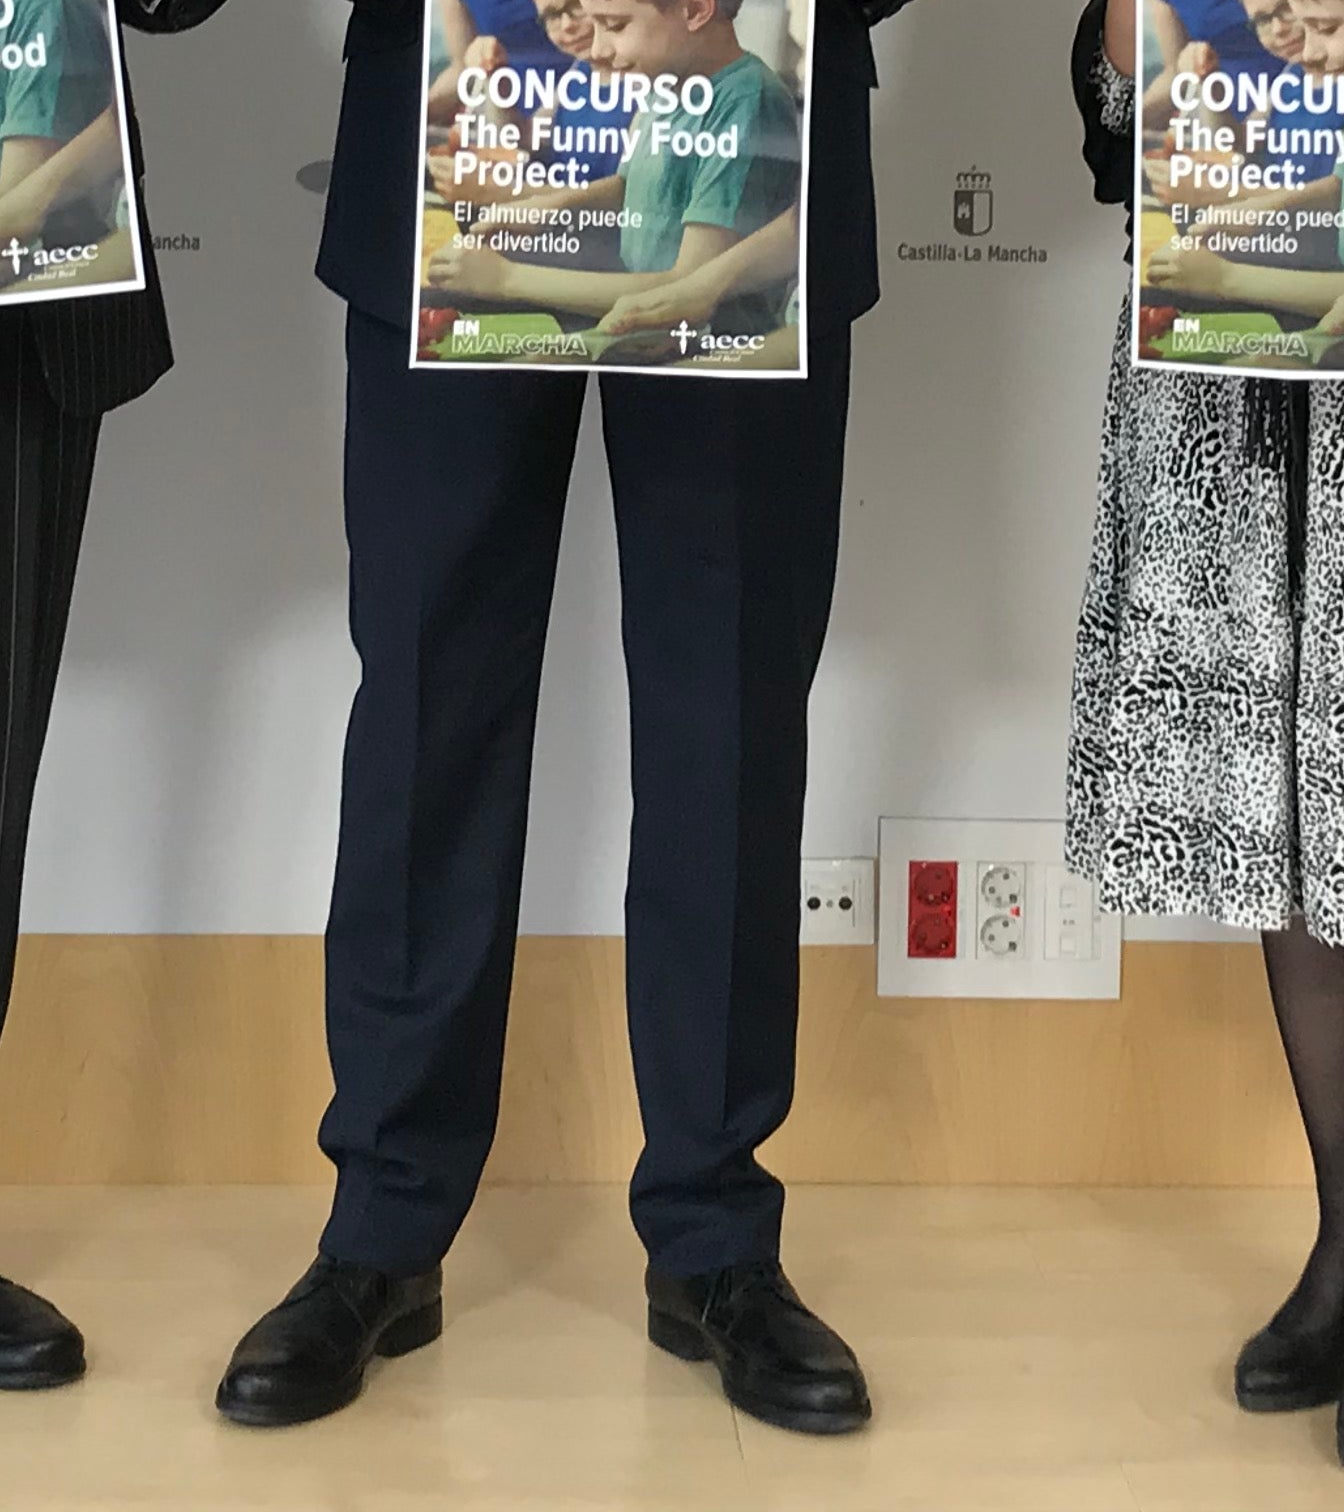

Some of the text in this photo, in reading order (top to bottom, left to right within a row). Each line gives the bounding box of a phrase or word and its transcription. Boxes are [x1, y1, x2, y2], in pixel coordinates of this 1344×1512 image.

[456, 66, 714, 115] CONCURSO
[455, 115, 738, 162] The Funny Food
[1169, 118, 1235, 152] The
[454, 152, 590, 195] Project:
[1170, 155, 1306, 196] Project:
[454, 202, 643, 232] El almuerzo puede
[1171, 204, 1189, 224] El
[1195, 205, 1289, 227] almuerzo
[152, 233, 200, 251] ancha
[453, 230, 580, 253] ser divertido
[897, 243, 1048, 263] Castilla-La Mancha
[1170, 232, 1298, 254] ser divertido
[34, 243, 99, 266] aecc
[453, 320, 479, 335] EN
[1173, 318, 1199, 332] EN
[452, 333, 588, 355] MARCHA
[701, 332, 765, 349] aecc
[1173, 331, 1307, 356] MARCHA
